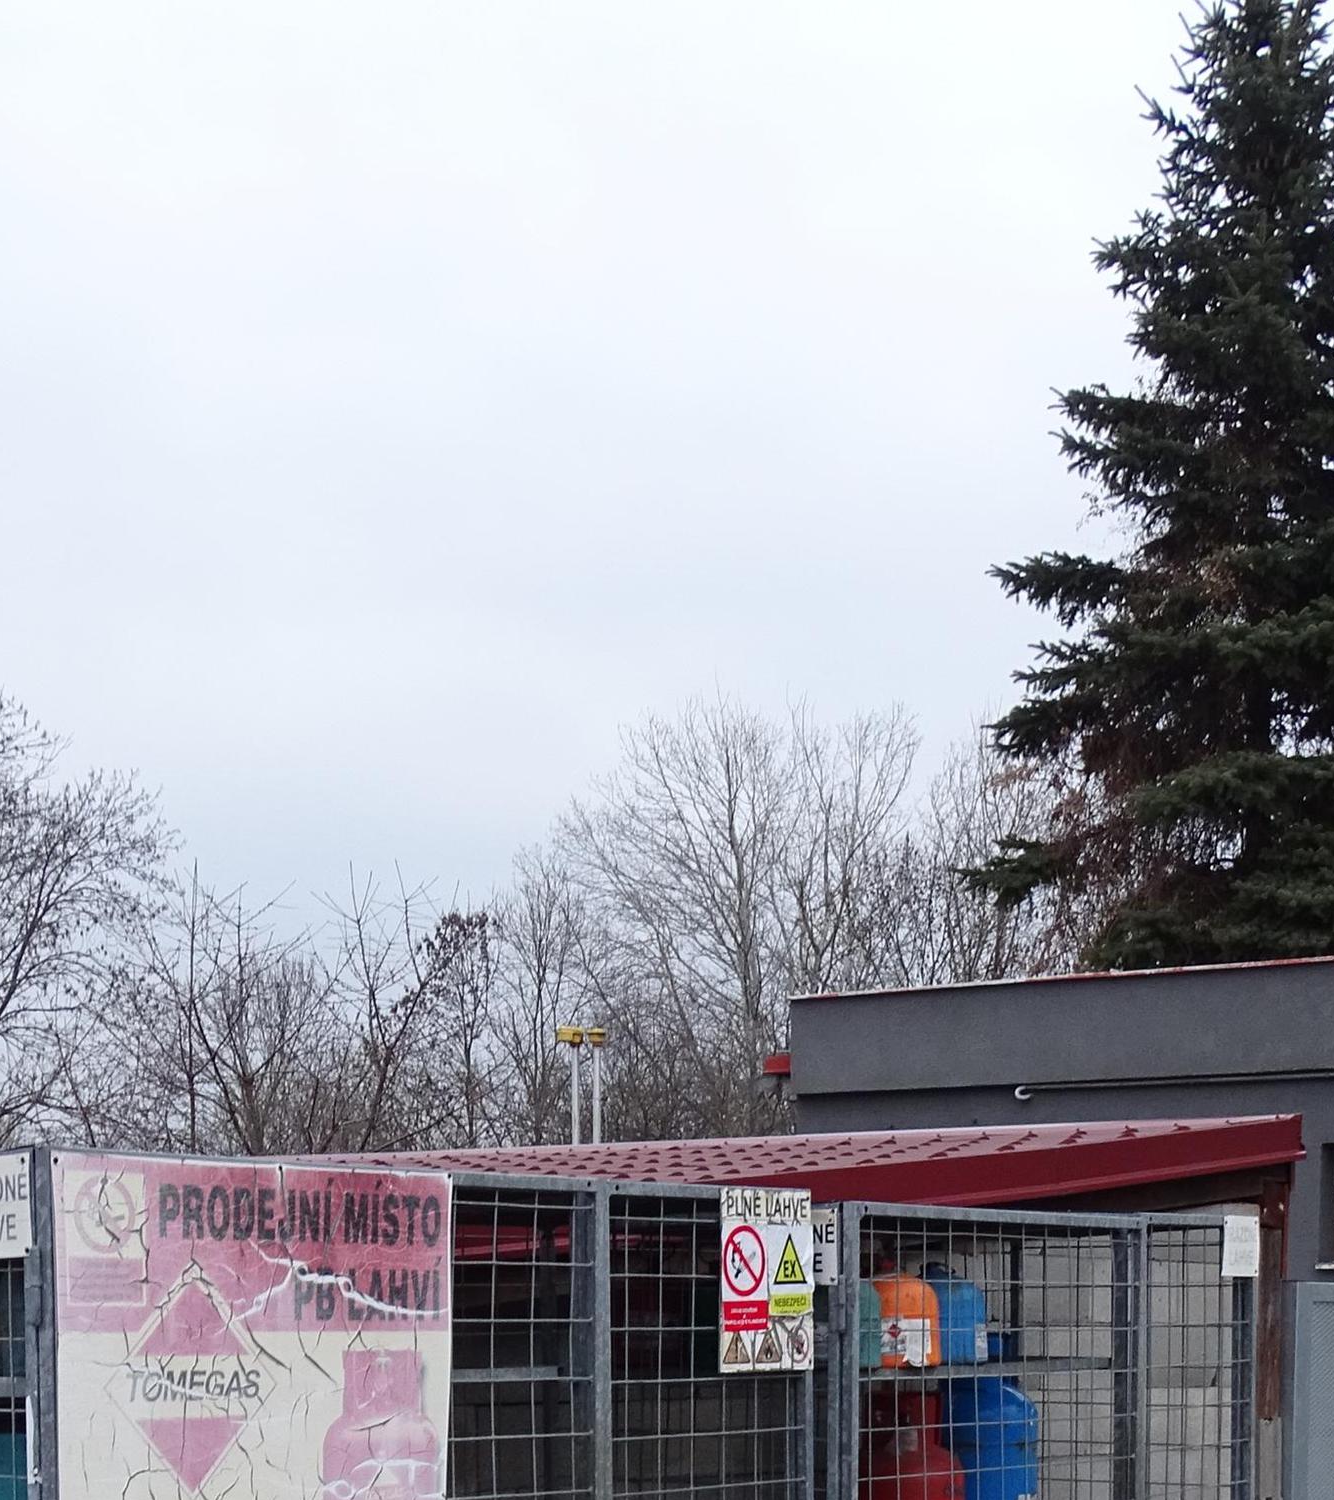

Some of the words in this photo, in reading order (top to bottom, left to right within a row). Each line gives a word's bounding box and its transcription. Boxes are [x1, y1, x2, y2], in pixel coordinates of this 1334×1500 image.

[158, 1178, 332, 1243] PRODEJNÍ
[343, 1178, 441, 1247] MÍSTO
[726, 1191, 762, 1217] PLNÉ
[766, 1196, 808, 1219] LAHVE
[783, 1261, 797, 1279] EX
[294, 1267, 335, 1322] PB
[347, 1257, 441, 1321] LAHVÍ
[125, 1368, 261, 1403] TOMEGAS
